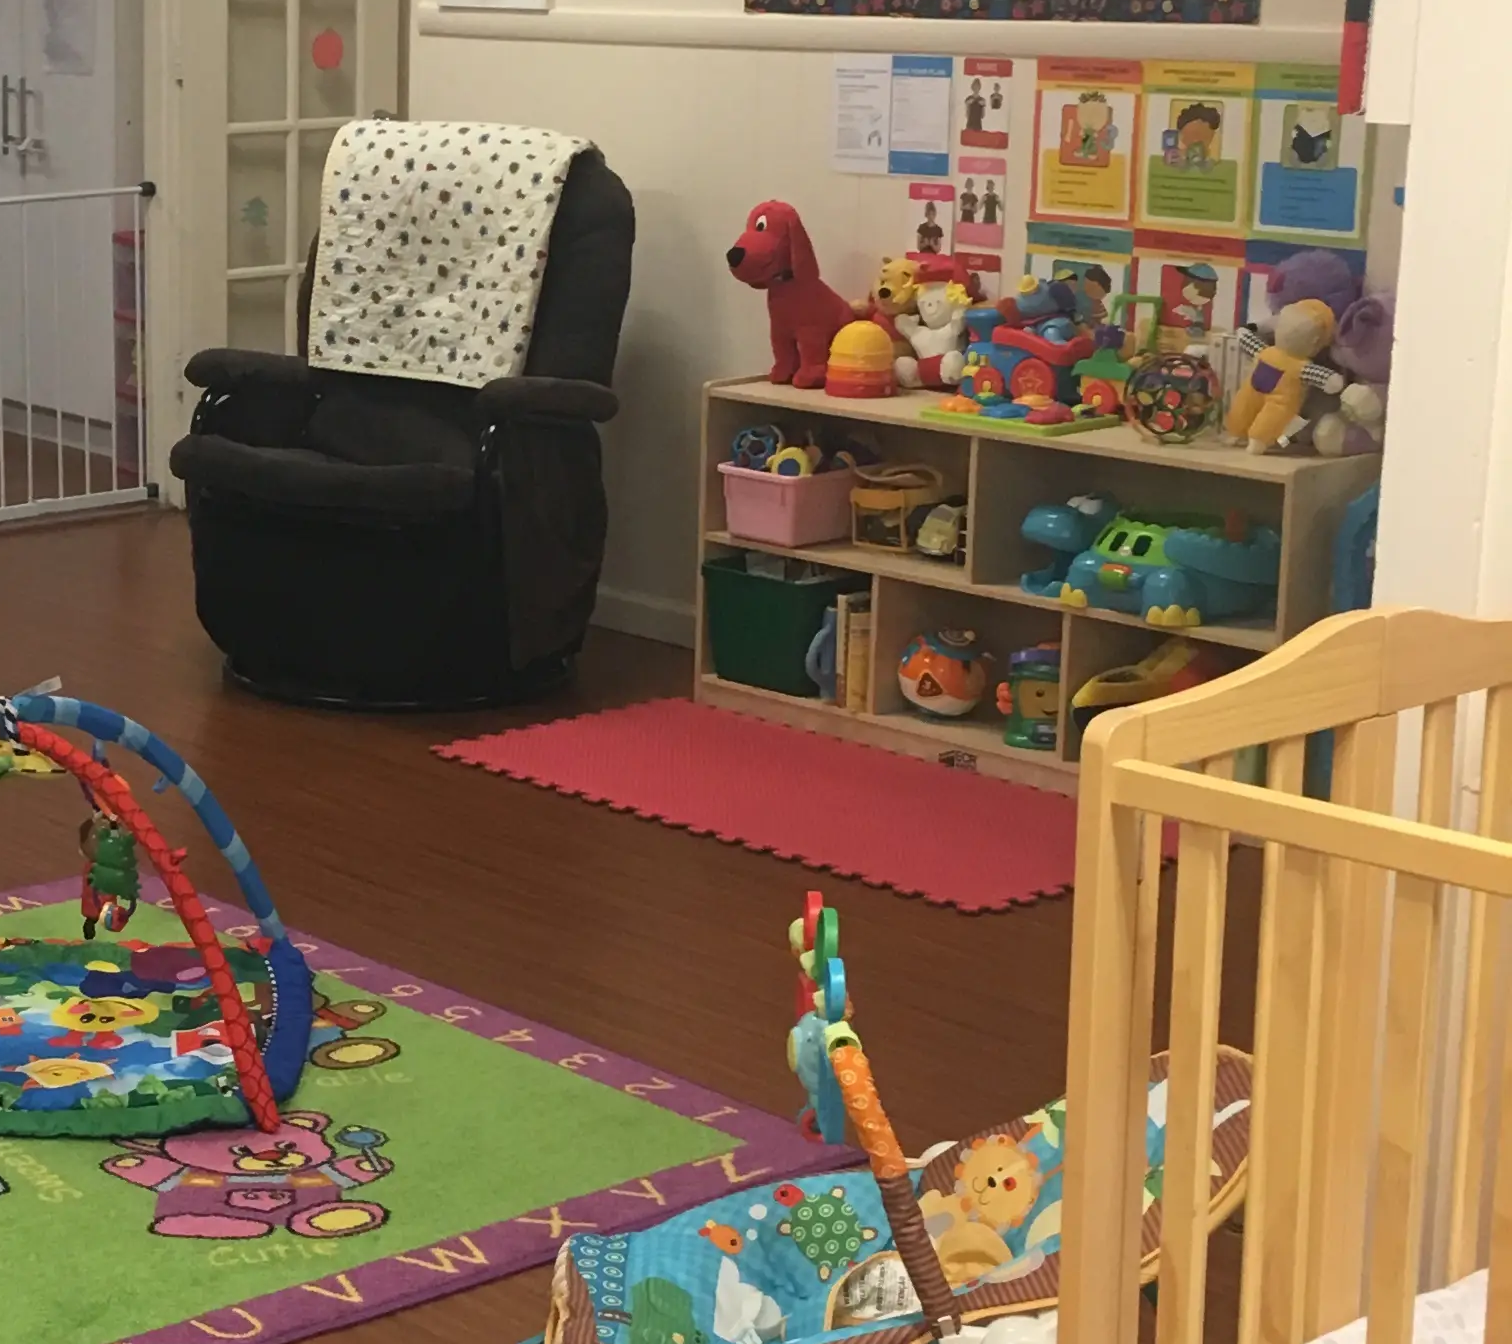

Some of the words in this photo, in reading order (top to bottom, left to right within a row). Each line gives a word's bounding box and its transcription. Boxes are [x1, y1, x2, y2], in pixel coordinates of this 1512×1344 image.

[430, 1006, 483, 1024] 5
[493, 1028, 535, 1042] 4
[558, 1052, 606, 1069] 3
[625, 1077, 676, 1096] 2
[191, 1308, 263, 1339] U
[303, 1274, 363, 1303] V
[395, 1236, 489, 1274] W
[514, 1206, 598, 1239] X
[609, 1178, 667, 1205] Y
[692, 1153, 773, 1183] Z
